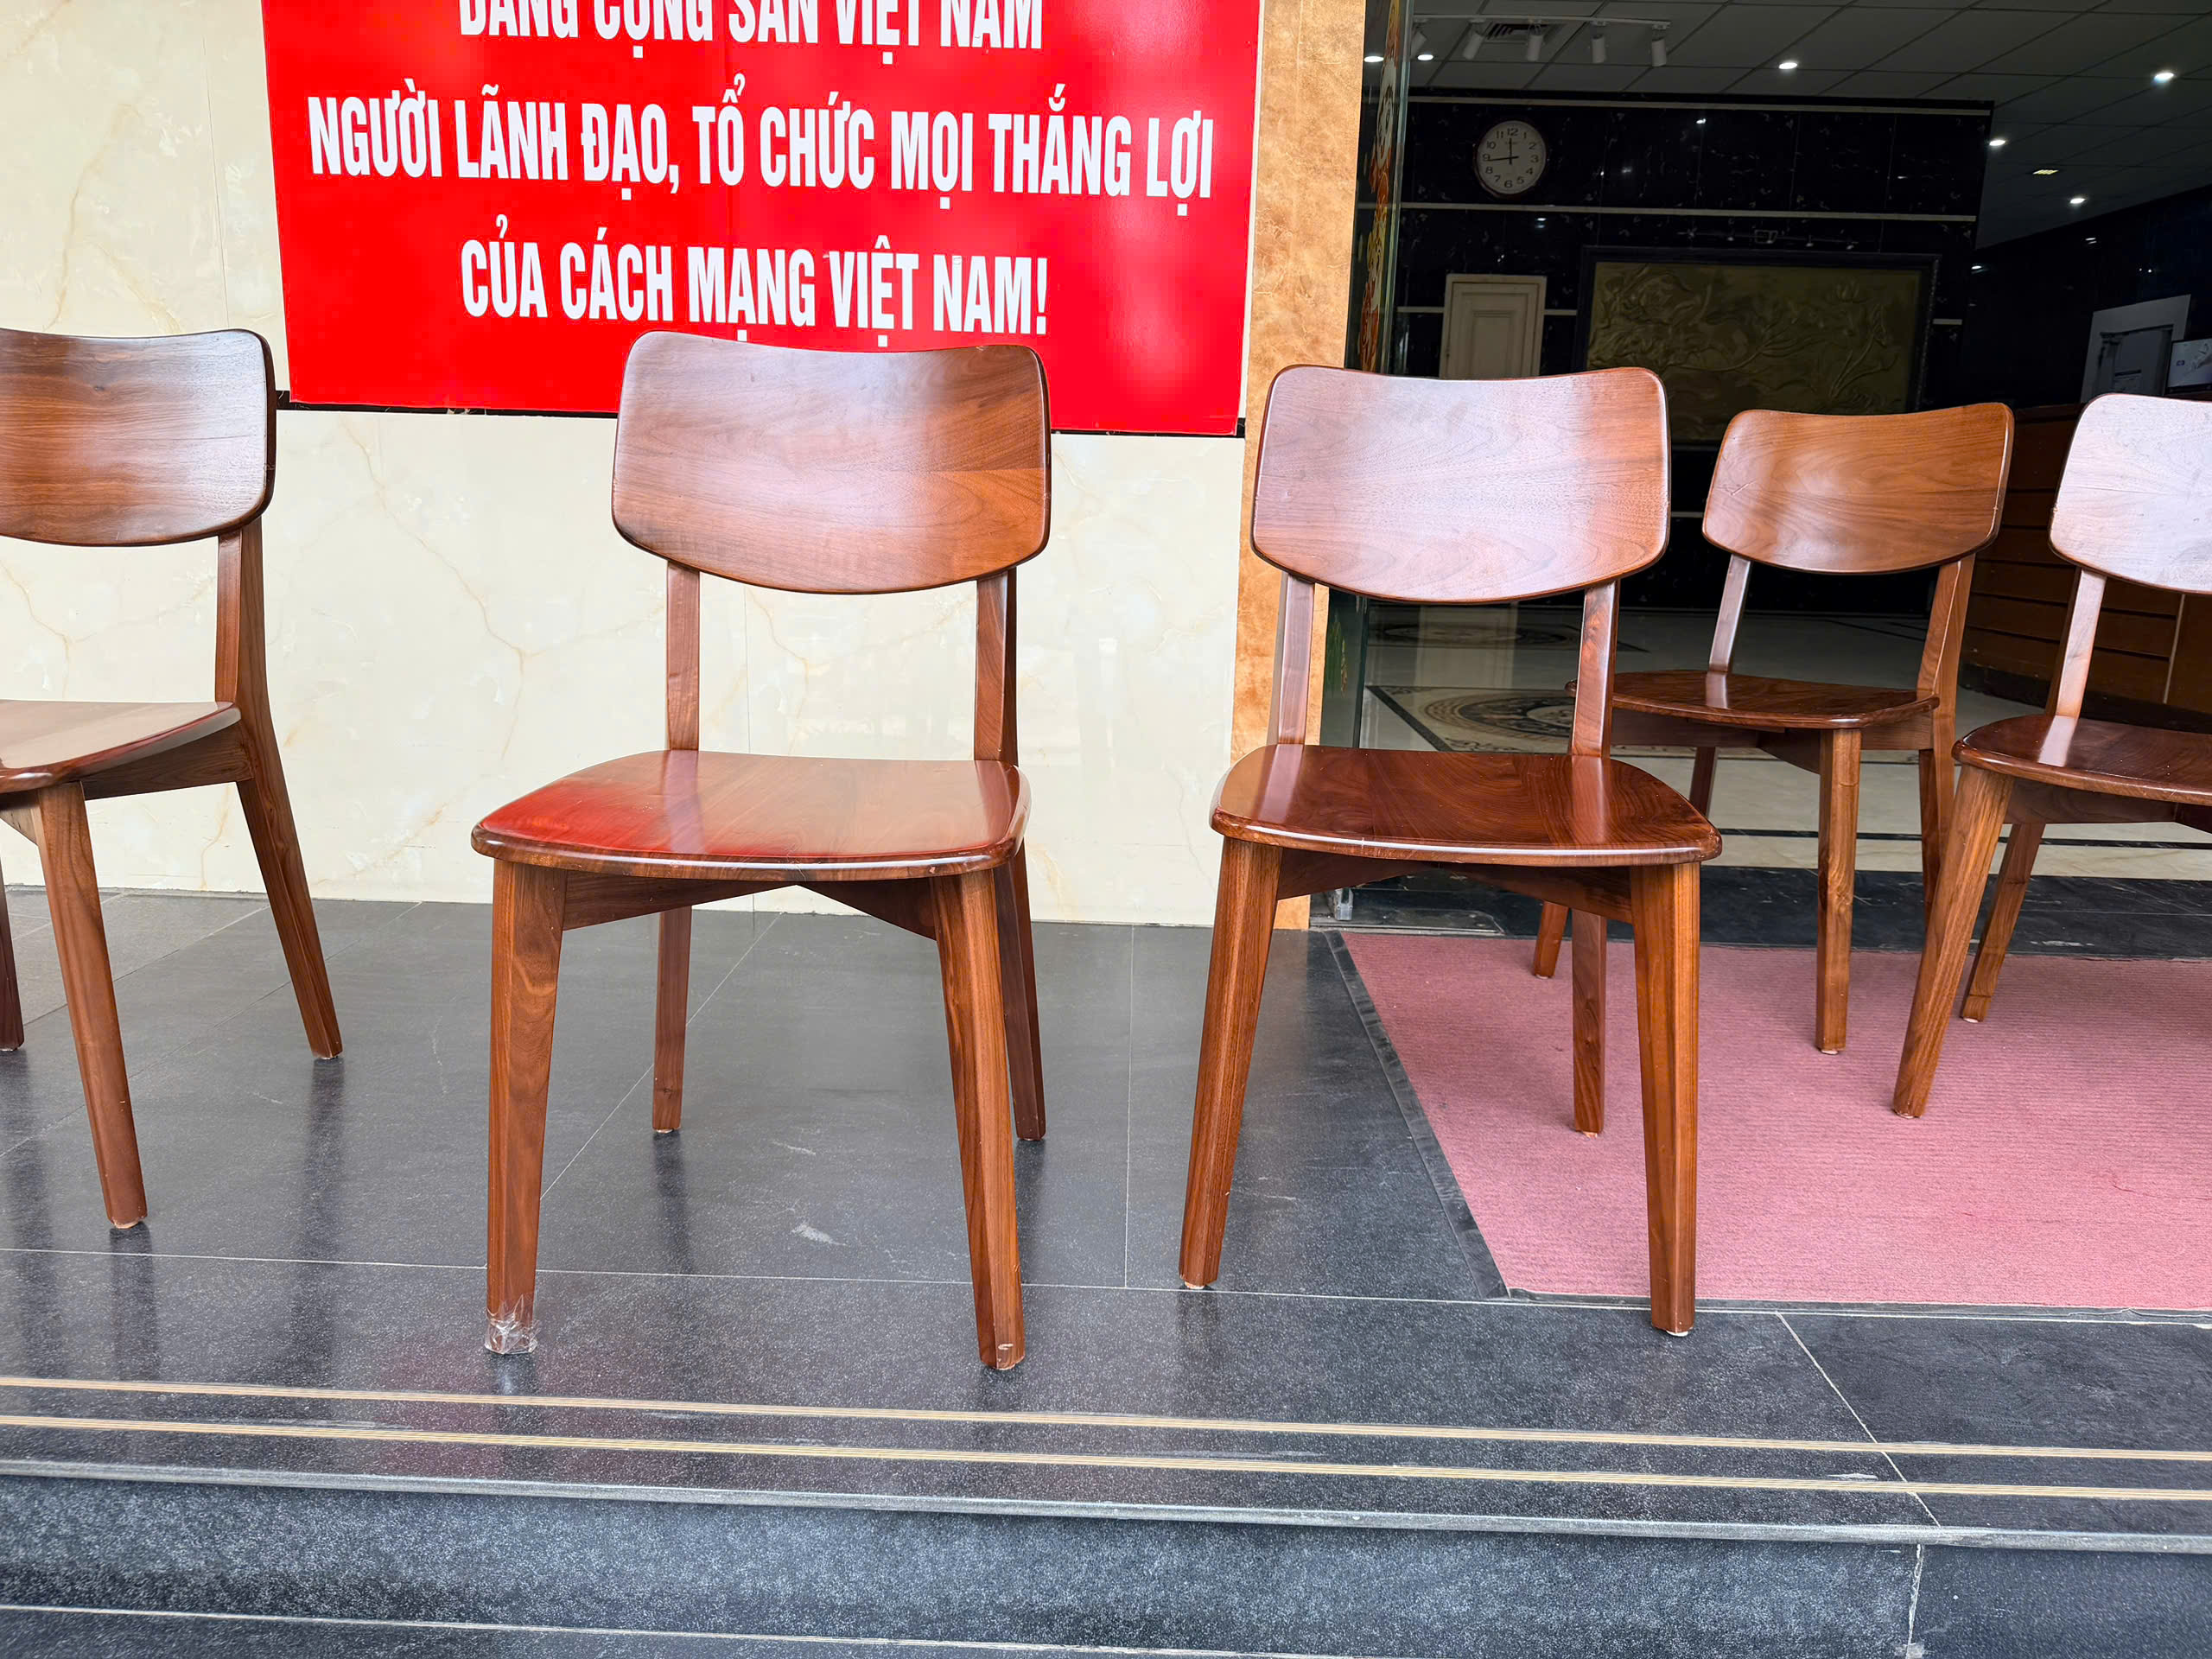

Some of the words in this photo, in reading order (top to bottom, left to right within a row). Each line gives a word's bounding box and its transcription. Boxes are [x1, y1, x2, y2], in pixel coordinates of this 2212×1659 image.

[940, 0, 1042, 49] NAM
[1496, 130, 1504, 139] 11
[1507, 128, 1519, 137] 12
[308, 78, 442, 178] NGƯỜI
[454, 84, 569, 181] LÃNH
[581, 103, 679, 201] ĐẠO,
[692, 73, 746, 186] TỔ
[760, 91, 874, 190] CHỨC
[891, 111, 974, 210] MỌI
[988, 83, 1132, 197] THẮNG
[1146, 110, 1214, 217] LỢI
[1486, 140, 1497, 149] 10
[1528, 142, 1536, 150] 2
[1482, 153, 1491, 162] 9
[1530, 155, 1540, 163] 3
[1485, 166, 1493, 175] 8
[1526, 167, 1534, 175] 4
[1494, 175, 1501, 183] 7
[1516, 175, 1525, 185] 5
[1504, 180, 1513, 188] 6
[461, 213, 548, 318] CỦA
[560, 226, 673, 321] CÁCH
[687, 246, 816, 342] MẠNG
[829, 234, 919, 347] VIỆT
[933, 254, 1048, 335] NAM!
